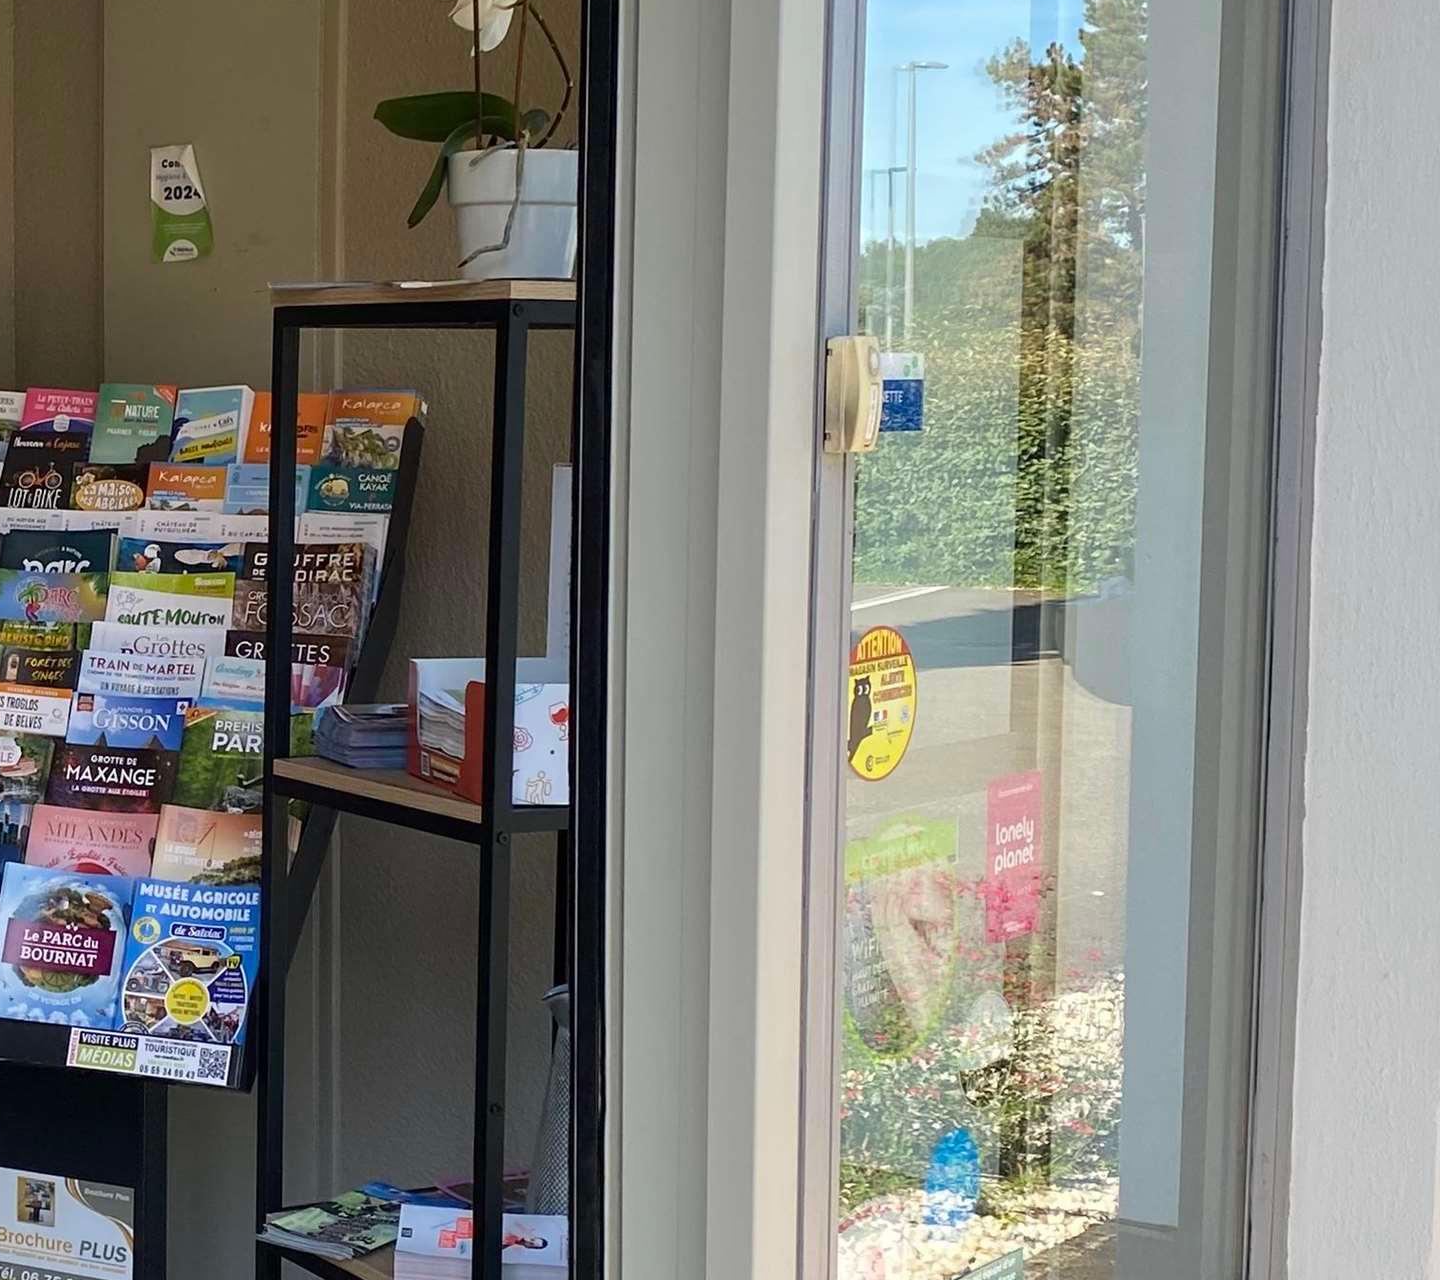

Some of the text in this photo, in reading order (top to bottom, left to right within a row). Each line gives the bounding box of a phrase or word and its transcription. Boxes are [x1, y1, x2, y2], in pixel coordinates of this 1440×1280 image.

[125, 404, 161, 419] NATURE
[359, 482, 389, 492] KAYAK
[133, 634, 206, 657] Grottes
[856, 628, 903, 661] ATTENTION
[31, 669, 65, 682] SINGES
[89, 657, 130, 671] TRAIN
[146, 663, 196, 677] MARTEL
[144, 685, 179, 696] SENSATIONS
[6, 695, 39, 711] TROGLOS
[4, 714, 14, 725] DE
[92, 706, 171, 732] GISSON
[91, 754, 137, 766] GROTTE DE
[65, 763, 156, 787] MAXANGE
[45, 821, 144, 844] MILANDES
[995, 816, 1035, 846] lonely
[994, 844, 1035, 876] planet
[140, 882, 259, 906] MUSÉE AGRICOLE
[145, 903, 251, 922] ET AUTOMOBILE
[23, 927, 100, 949] Le PARC du
[174, 924, 187, 936] de
[19, 945, 98, 968] BOURNAT
[81, 1031, 112, 1047] VISITE
[112, 1035, 138, 1049] PLUS
[145, 1042, 197, 1058] TOURISTIQUE
[79, 1045, 135, 1068] MÉDIAS
[79, 1240, 127, 1263] PLUS
